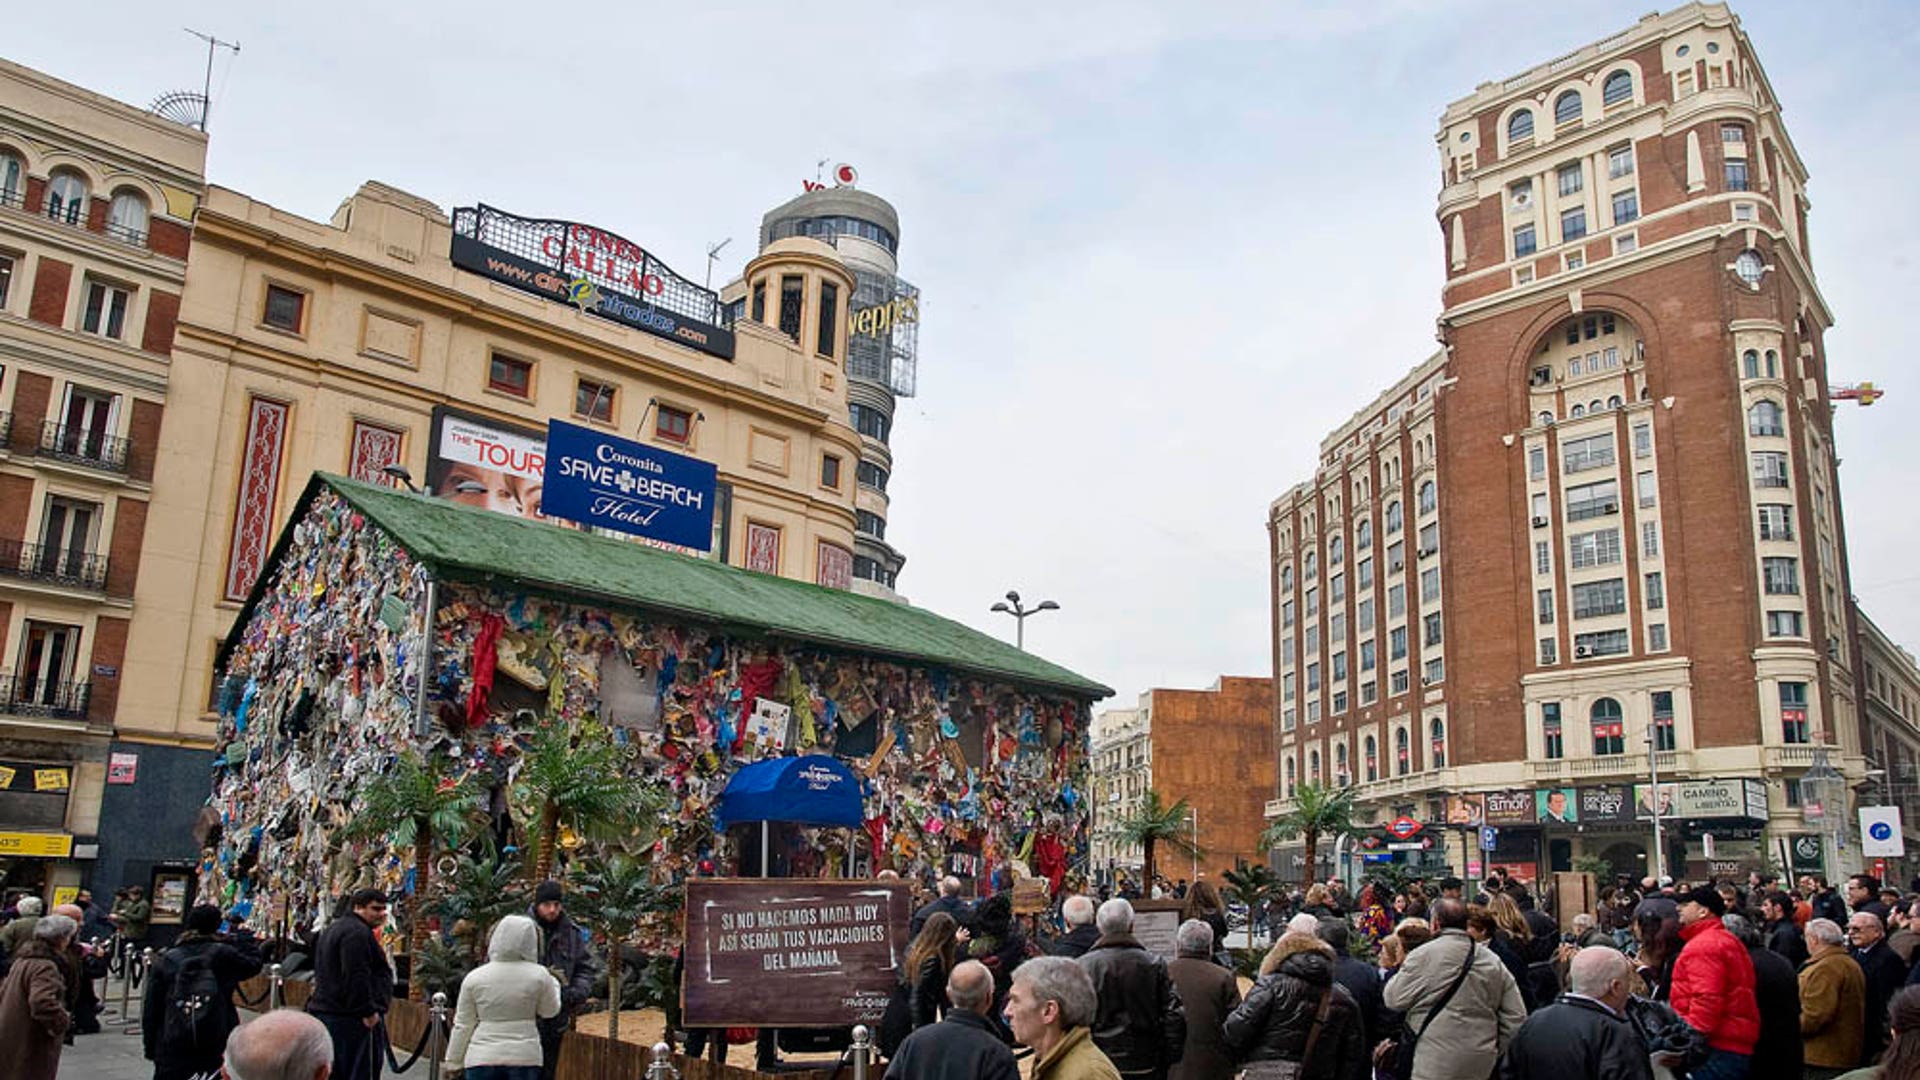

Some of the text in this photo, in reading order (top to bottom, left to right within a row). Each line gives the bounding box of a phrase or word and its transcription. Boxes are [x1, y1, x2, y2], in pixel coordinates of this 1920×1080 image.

[571, 224, 643, 263] CINES
[542, 236, 664, 296] CALLAO
[451, 432, 473, 447] THE
[596, 443, 663, 474] Coronita
[559, 455, 703, 510] SAVE BEACH
[590, 494, 660, 527] Hotel
[1683, 787, 1729, 800] CAMINO
[1600, 801, 1623, 814] REY
[721, 904, 878, 931] SI NO HACEMOS NADA HOY
[719, 925, 884, 952] ASÍ SERÁN TUS VACACIONES
[764, 953, 786, 971] DEL
